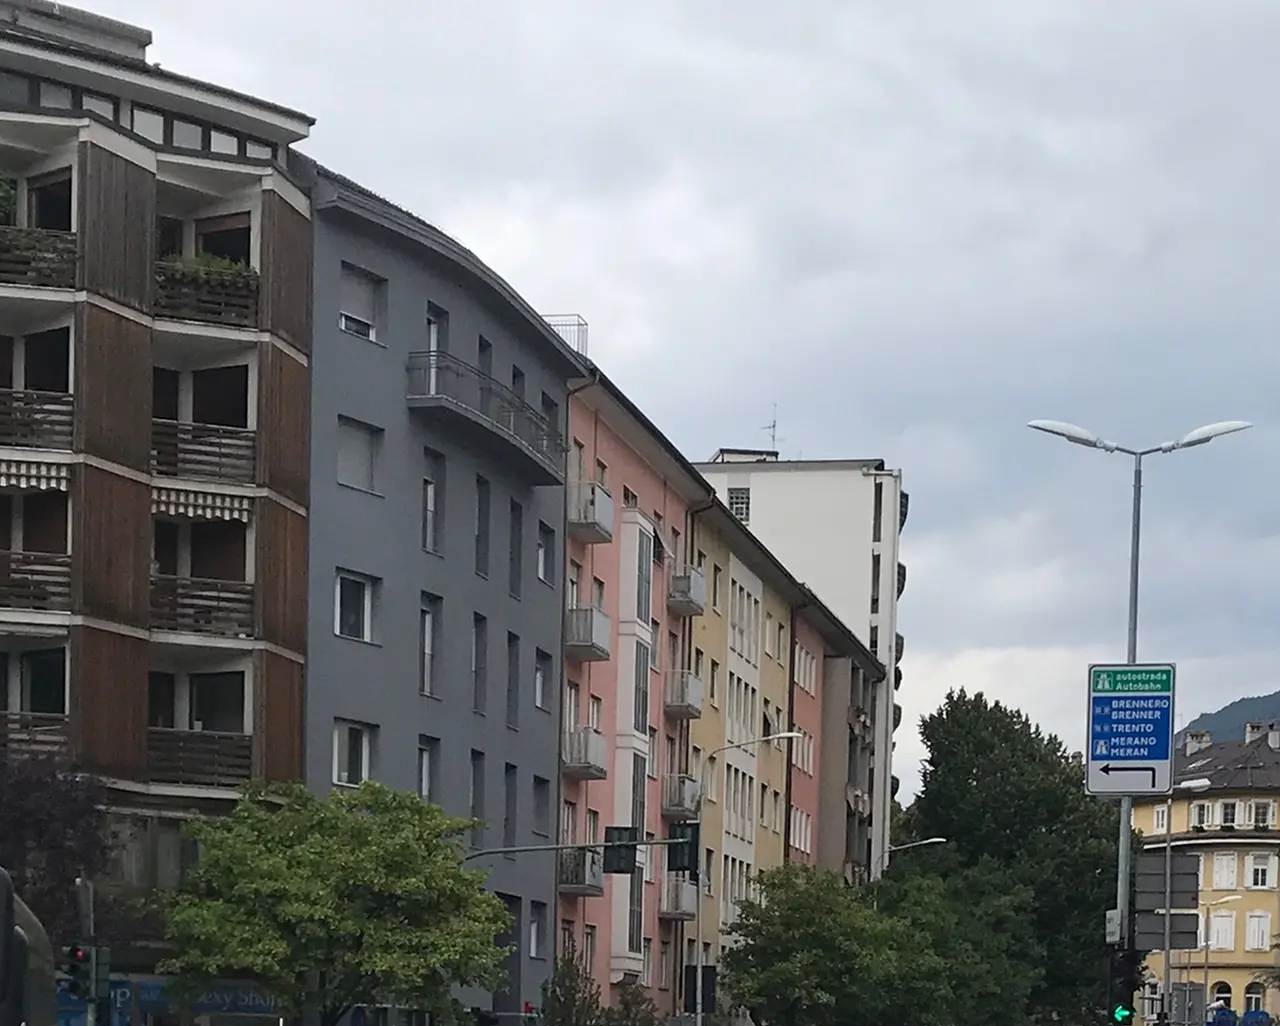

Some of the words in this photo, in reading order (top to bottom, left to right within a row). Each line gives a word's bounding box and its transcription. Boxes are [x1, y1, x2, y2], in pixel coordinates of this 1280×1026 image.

[1116, 673, 1167, 681] autostrada
[1116, 682, 1161, 691] Autobahn
[1112, 699, 1169, 709] BRENNERO
[1111, 710, 1161, 720] BRENNER
[1111, 724, 1154, 733] TRENTO
[1110, 737, 1157, 746] MERANO
[1110, 748, 1149, 757] MERAN
